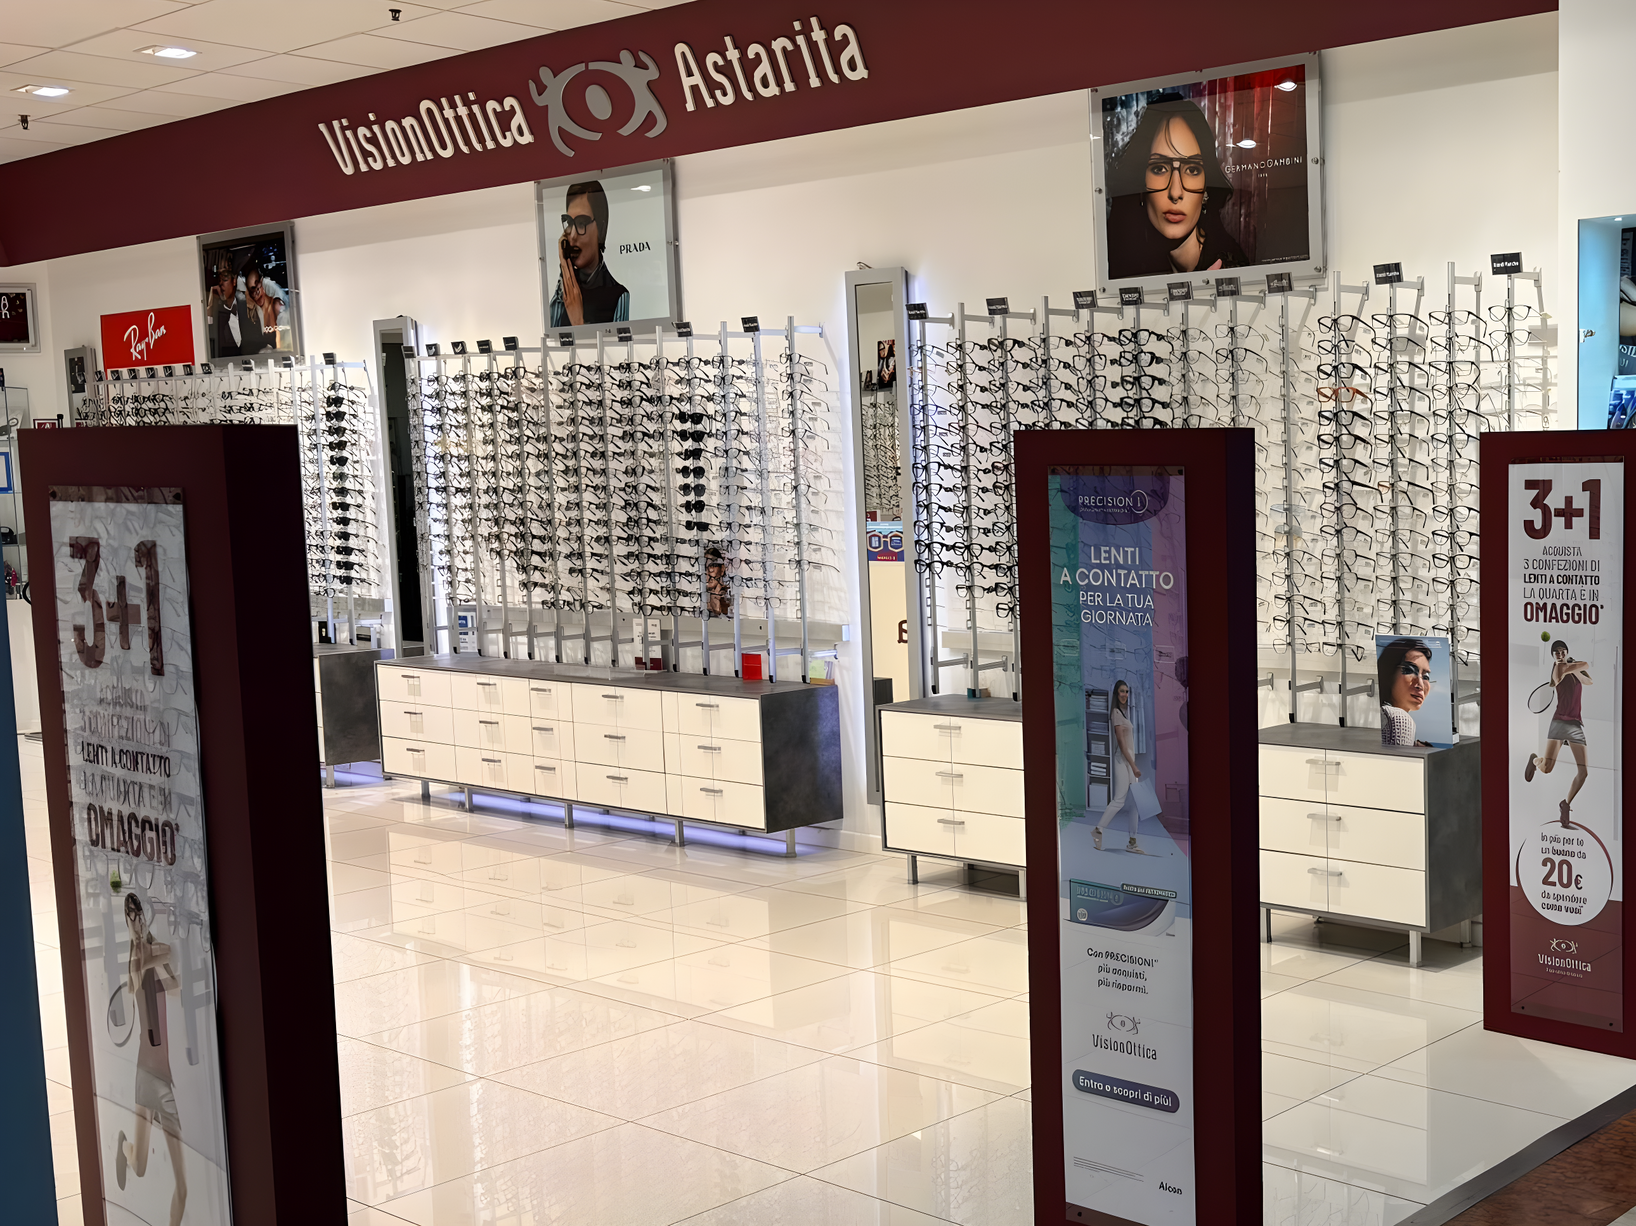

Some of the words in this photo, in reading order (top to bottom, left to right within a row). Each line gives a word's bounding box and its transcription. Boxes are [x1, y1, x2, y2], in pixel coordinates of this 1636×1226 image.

[318, 92, 535, 176] VisionOttica
[673, 15, 869, 112] Astarita
[619, 241, 651, 254] PRADA
[1523, 478, 1602, 540] 3+1
[1090, 545, 1140, 565] LENTI
[1542, 545, 1582, 557] ACQUISTA
[1532, 558, 1588, 572] CONFEZIONI
[1590, 560, 1600, 572] DI
[1060, 567, 1072, 585] A
[1075, 568, 1174, 590] CONTATTO
[1549, 574, 1555, 584] A
[1556, 574, 1600, 586] CONTATTO
[1080, 591, 1103, 606] PER
[1106, 592, 1124, 607] LA
[1125, 594, 1155, 609] TUA
[1523, 587, 1536, 599] LA
[1538, 587, 1577, 601] QUARTA
[1588, 589, 1599, 602] IN
[68, 535, 165, 677] 3+1
[1080, 609, 1153, 627] GIORNATA
[1086, 947, 1104, 959] Con
[1097, 963, 1111, 974] più
[1537, 953, 1592, 973] VisionOttica
[1097, 977, 1111, 988] più
[1092, 1033, 1158, 1060] VisionOttica
[1143, 1091, 1153, 1102] di
